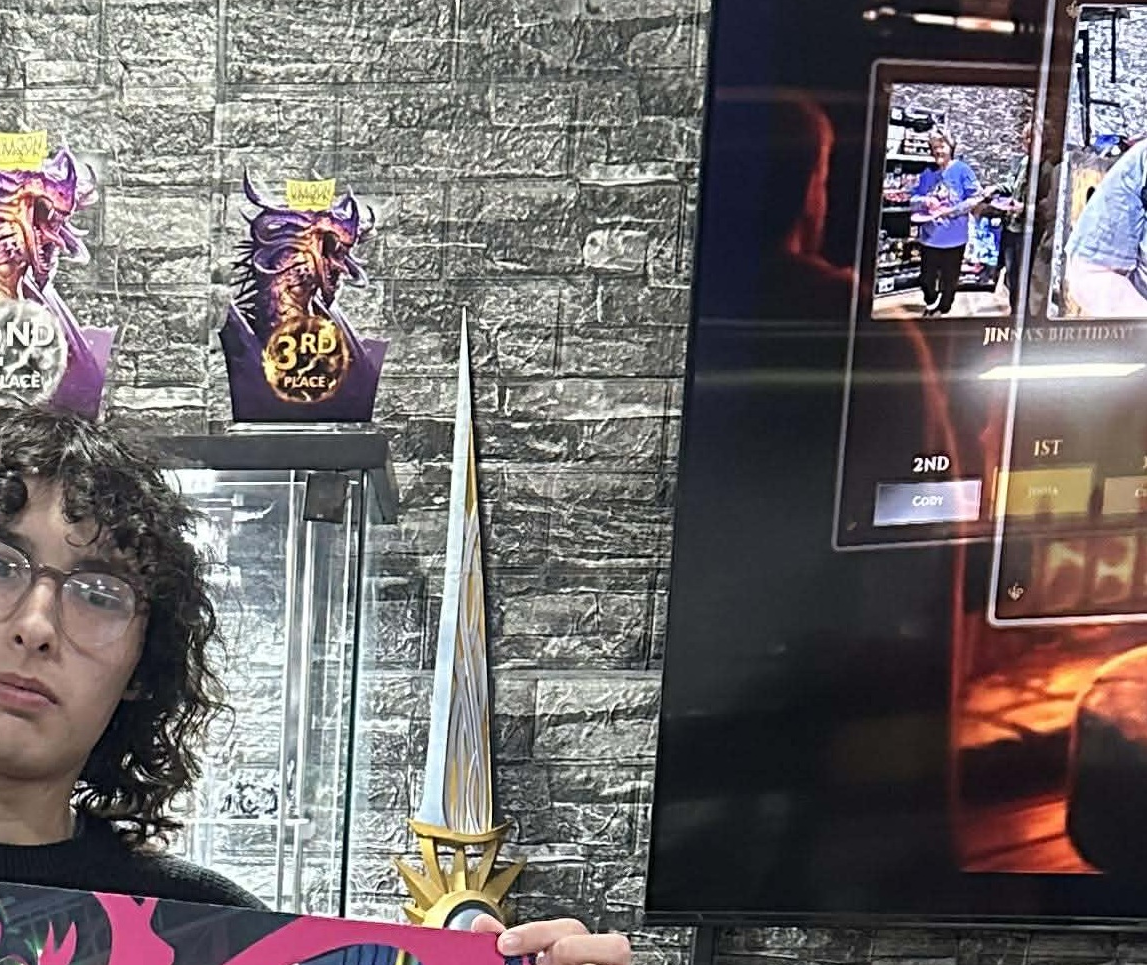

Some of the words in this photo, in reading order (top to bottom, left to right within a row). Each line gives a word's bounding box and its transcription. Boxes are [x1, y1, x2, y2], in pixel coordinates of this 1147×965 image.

[275, 332, 337, 371] 3RD
[283, 376, 326, 388] PLACE
[1033, 438, 1064, 456] 1ST
[912, 455, 951, 474] 2ND
